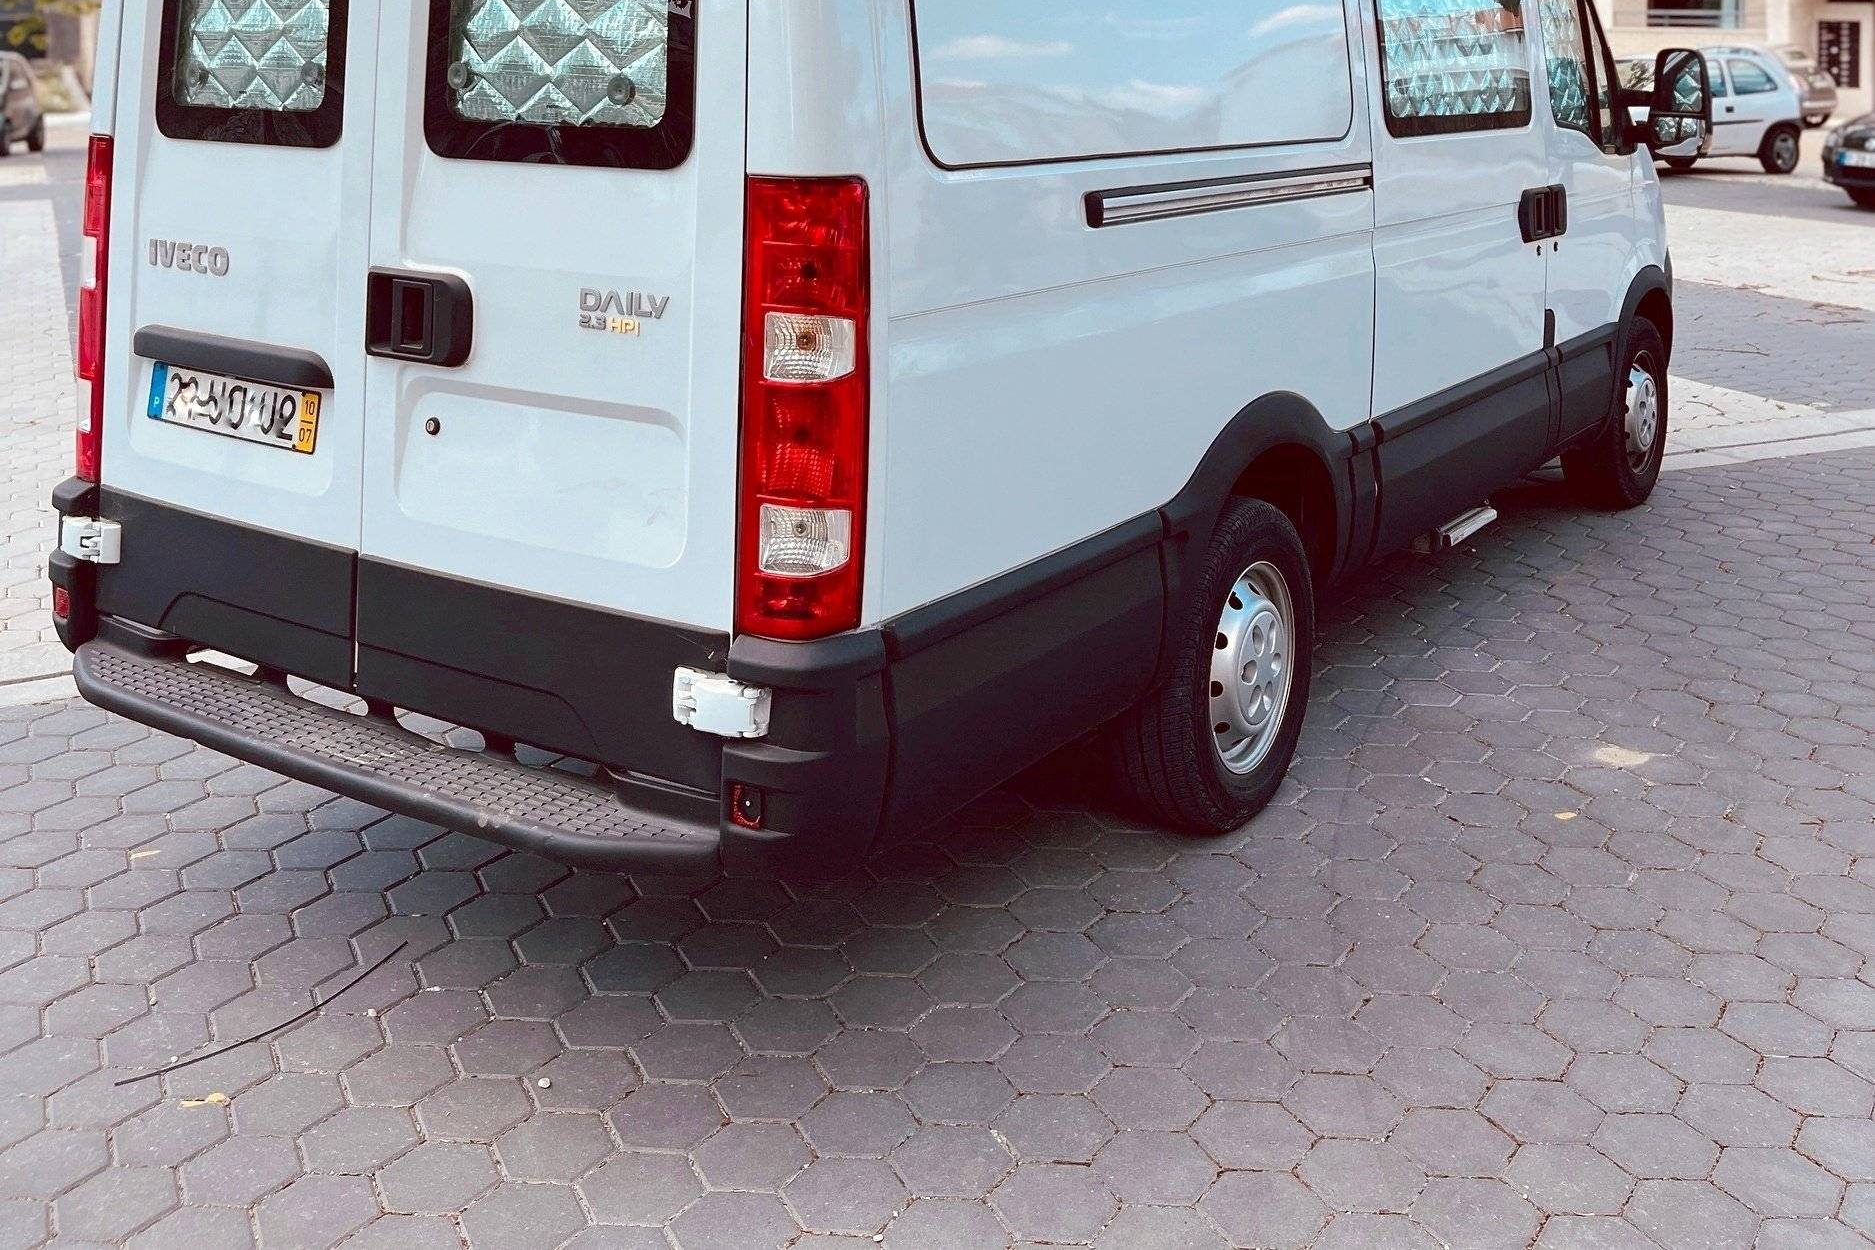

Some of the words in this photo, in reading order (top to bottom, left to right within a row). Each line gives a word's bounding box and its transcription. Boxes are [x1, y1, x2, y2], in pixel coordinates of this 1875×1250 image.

[149, 238, 230, 277] IVECO
[579, 287, 670, 320] DAILY
[153, 397, 160, 407] P
[305, 399, 315, 417] 10
[298, 428, 312, 443] 07
